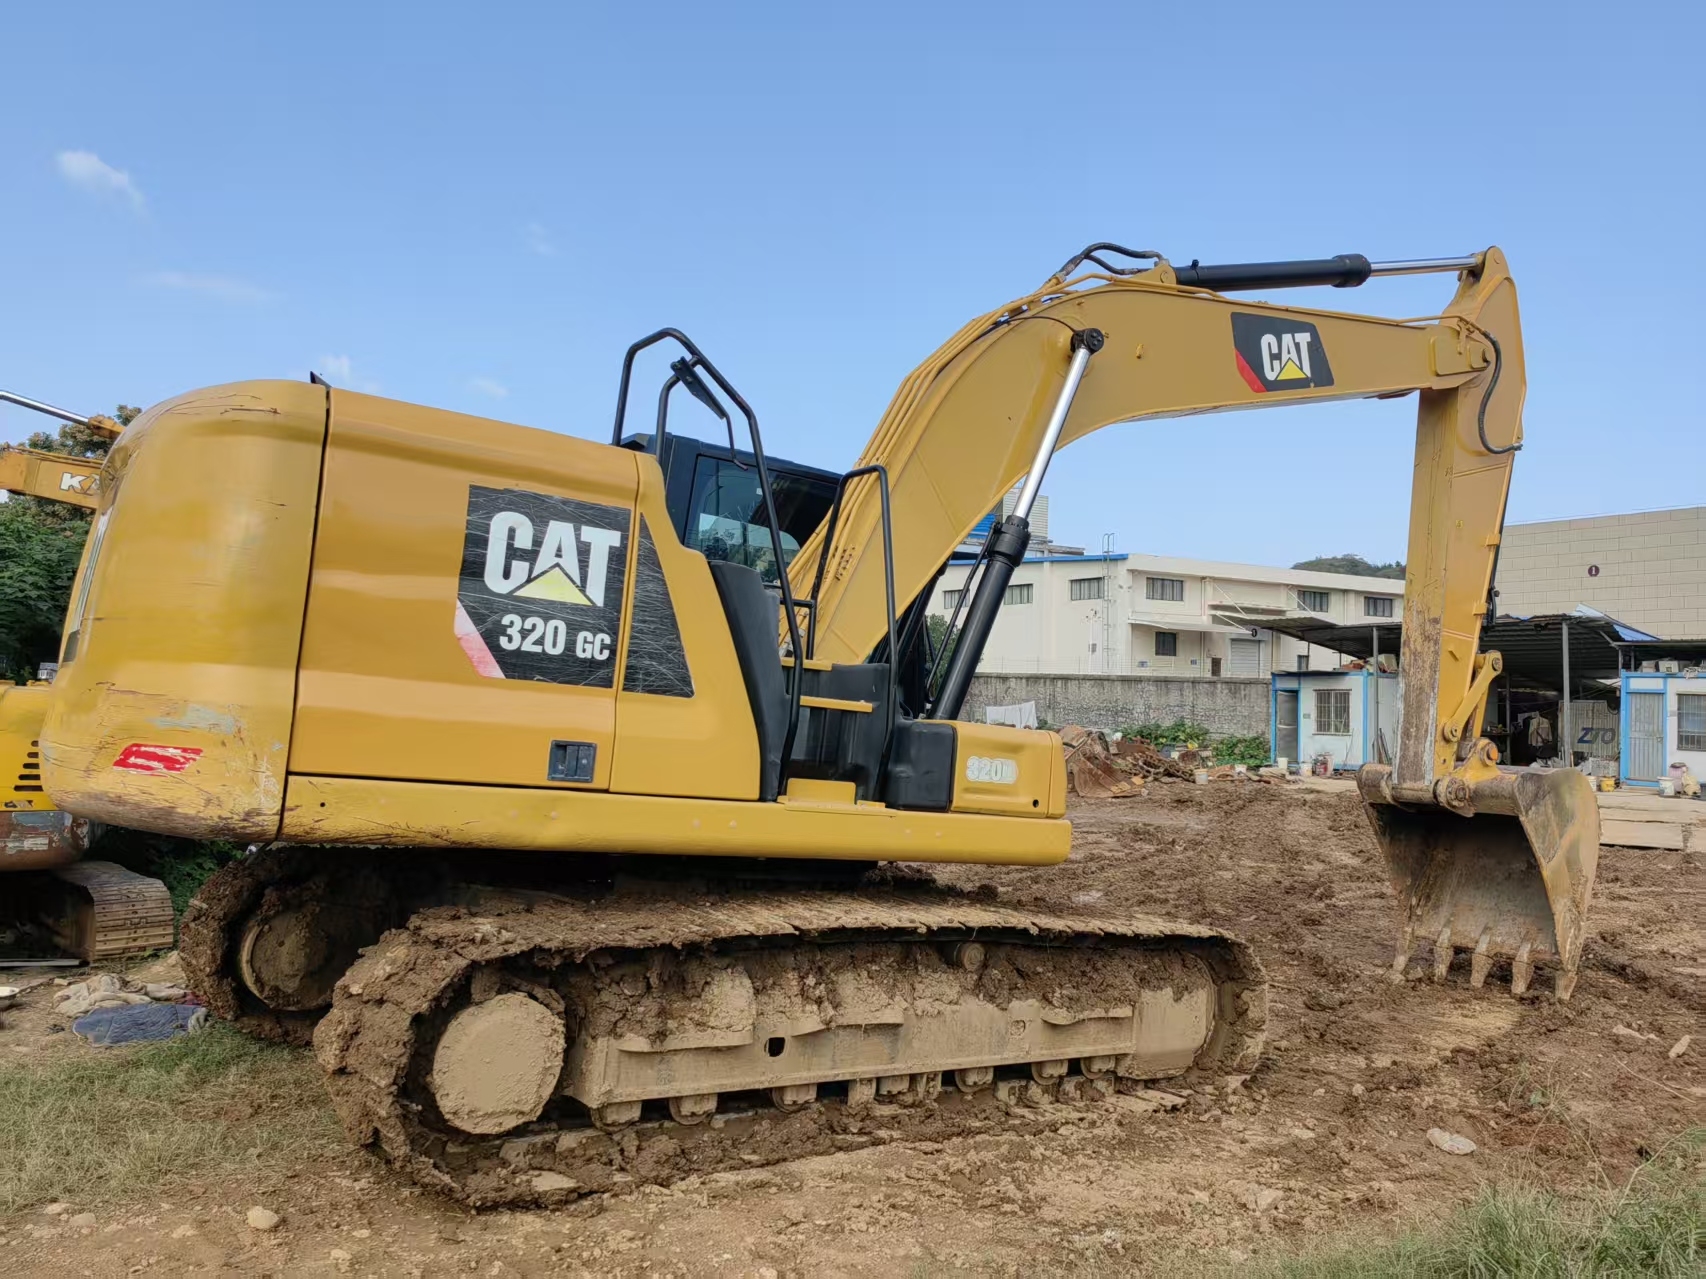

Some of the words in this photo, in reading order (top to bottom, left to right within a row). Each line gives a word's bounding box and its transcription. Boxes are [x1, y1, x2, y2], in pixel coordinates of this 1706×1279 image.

[1260, 332, 1311, 381] CAT
[484, 511, 622, 607] CAT
[499, 613, 568, 656] 320
[575, 630, 612, 661] GC
[1577, 726, 1617, 745] ZTO
